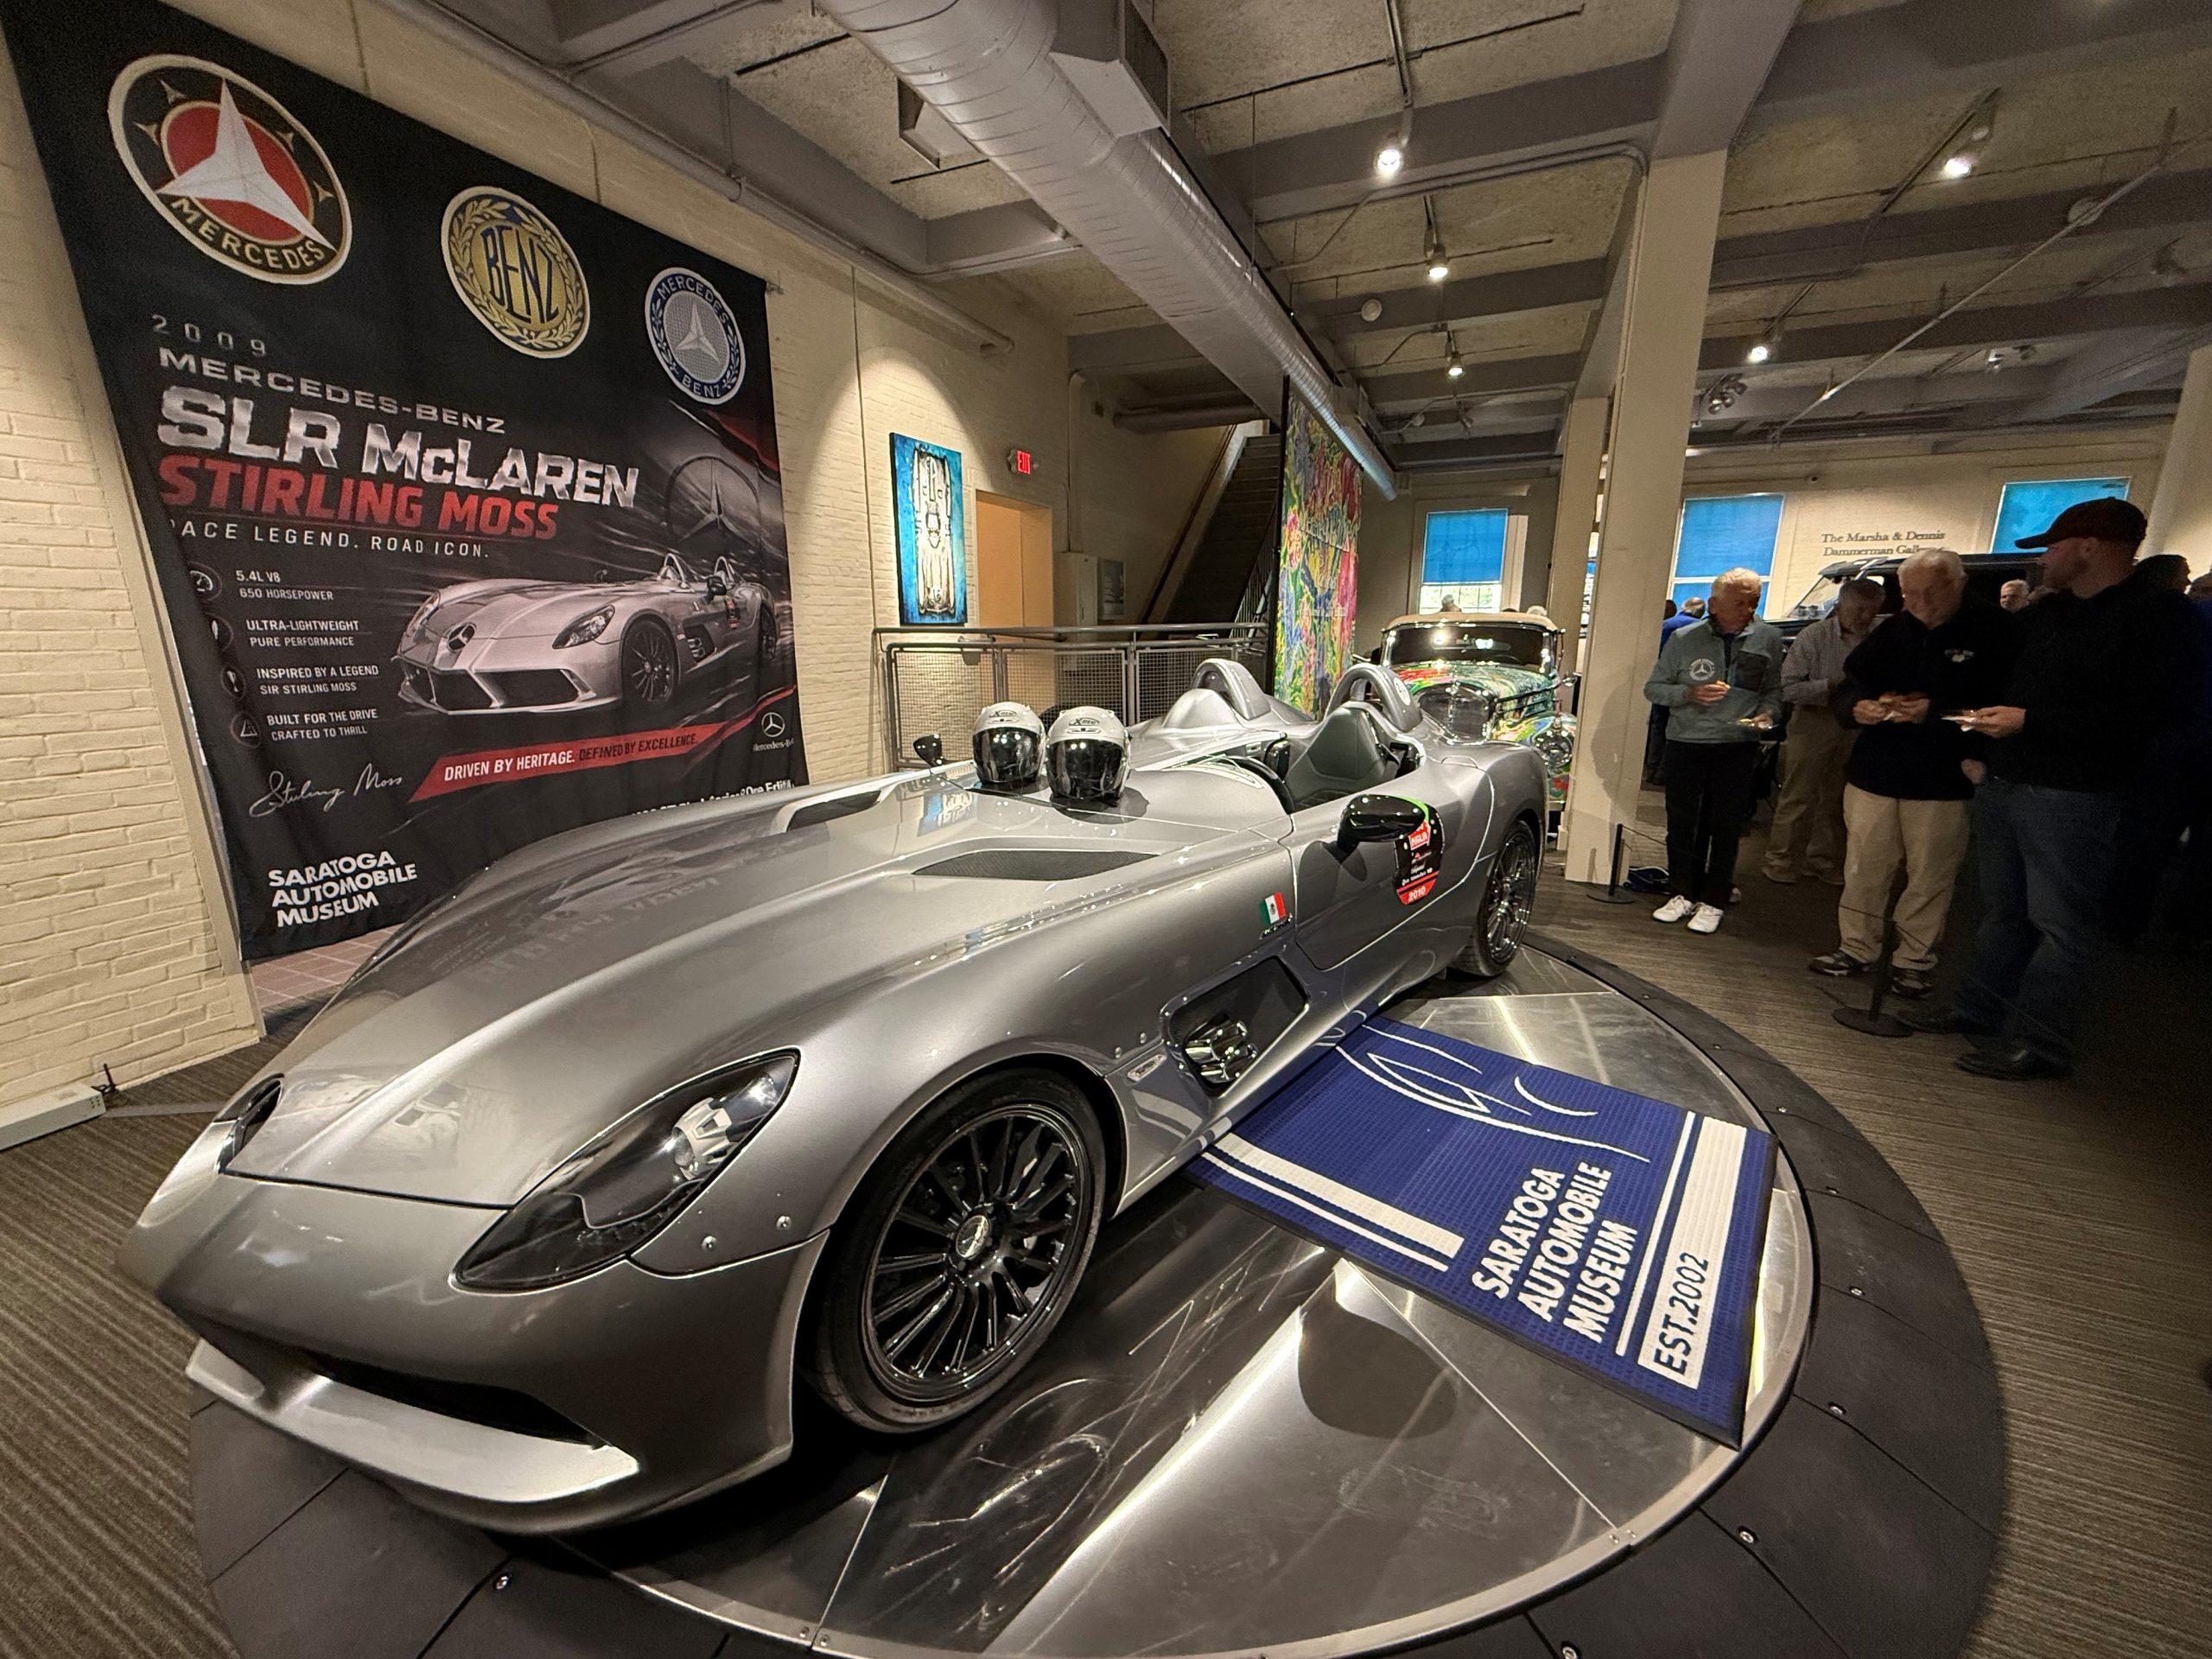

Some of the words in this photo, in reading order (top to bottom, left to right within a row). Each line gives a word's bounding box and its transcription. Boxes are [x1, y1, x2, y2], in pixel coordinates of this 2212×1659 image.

[171, 197, 326, 270] MERCEDES
[479, 224, 560, 325] BENZ
[658, 275, 728, 324] MERCEDES
[151, 314, 266, 357] 2009
[157, 346, 505, 435] MERCEDES-BENZ
[682, 374, 722, 398] BENZ
[157, 385, 340, 469] SLR
[361, 422, 640, 508] McLAREN
[158, 454, 423, 529] STIRLING
[437, 490, 559, 540] MOSS
[169, 519, 238, 540] ACE
[254, 527, 359, 550] LEGEND.
[371, 536, 425, 555] ROAD
[435, 541, 490, 559] ICON.
[1821, 533, 1844, 543] The
[1846, 532, 1890, 543] Marsha
[1891, 531, 1903, 541] &
[1905, 530, 1946, 541] Dennis
[1822, 546, 1894, 557] Dammerman
[235, 569, 264, 582] 5.4L
[265, 571, 281, 583] V8
[239, 588, 263, 599] 650
[266, 588, 334, 601] HORSEPOWER
[246, 619, 359, 632] ULTRA-LIGHTWEIGHT
[250, 637, 281, 647] PURE
[284, 636, 354, 647] PERFORMANCE
[257, 668, 312, 680] INSPIRED
[315, 667, 327, 678] BY
[330, 666, 338, 677] A
[340, 665, 379, 677] LEGEND
[260, 685, 279, 696] SIR
[283, 683, 328, 695] STIRLING
[331, 682, 357, 692] MOSS
[267, 713, 300, 727] BUILT
[304, 712, 327, 724] FOR
[328, 710, 347, 722] THE
[349, 709, 378, 721] DRIVE
[271, 728, 321, 741] CRAFTED
[323, 728, 336, 738] TO
[339, 725, 367, 735] THRILL
[443, 760, 490, 782] DRIVEN
[493, 757, 514, 774] BY
[517, 750, 575, 771] HERITAGE.
[579, 745, 625, 761] DEFINED
[625, 741, 637, 754] BY
[639, 733, 698, 753] EXCELLENCE.
[353, 762, 403, 797] Moss
[268, 850, 397, 887] SARATOGA
[271, 863, 418, 908] AUTOMOBILE
[276, 891, 380, 928] MUSEUM
[1408, 886, 1427, 903] 2010
[1471, 1167, 1566, 1300] SARATOGA
[1516, 1161, 1612, 1323] AUTOMOBILE
[1562, 1219, 1639, 1344] MUSEUM
[1653, 1251, 1709, 1376] EST.2002
